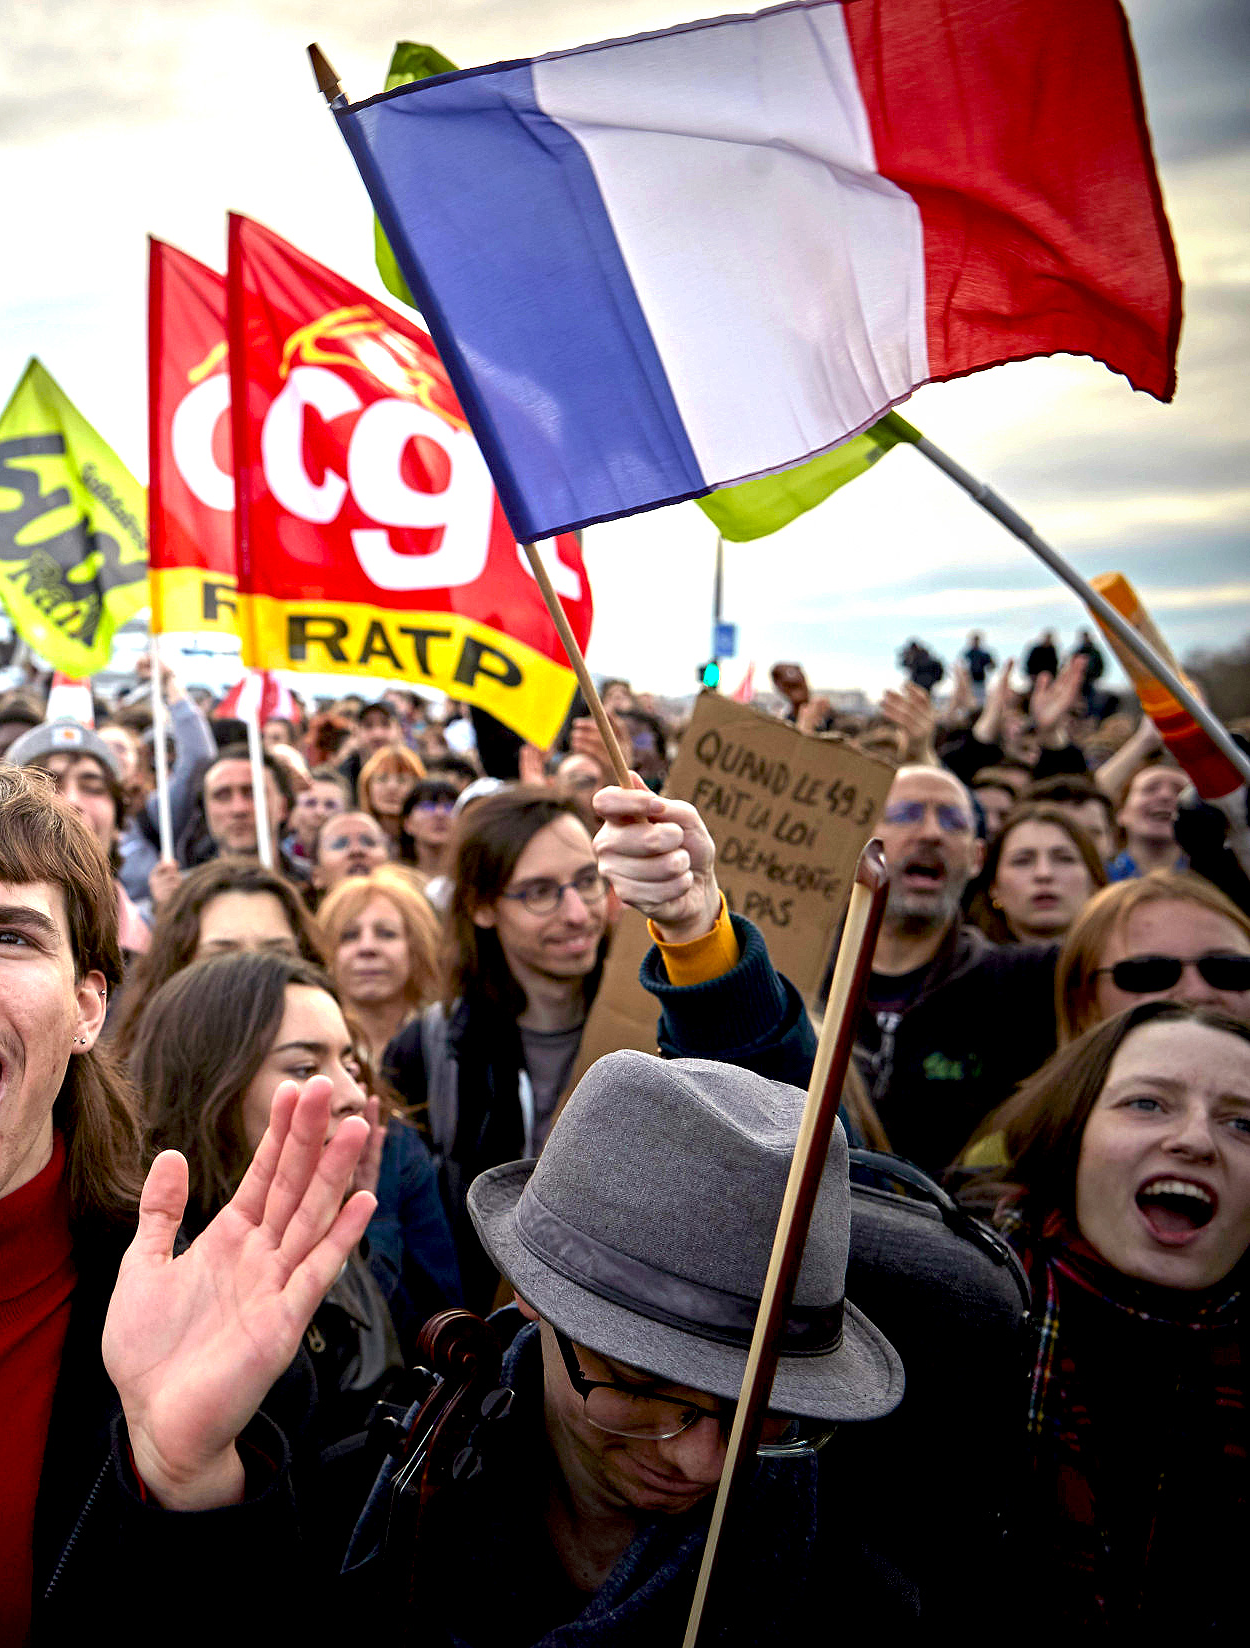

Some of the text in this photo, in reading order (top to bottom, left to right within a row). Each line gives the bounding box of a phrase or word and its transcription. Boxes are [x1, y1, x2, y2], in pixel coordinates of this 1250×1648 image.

[286, 614, 524, 690] RATP
[695, 728, 790, 796] QUAND
[792, 772, 825, 806] LE
[693, 775, 752, 821] FAIT
[745, 803, 771, 831] LA
[743, 889, 794, 927] PAS
